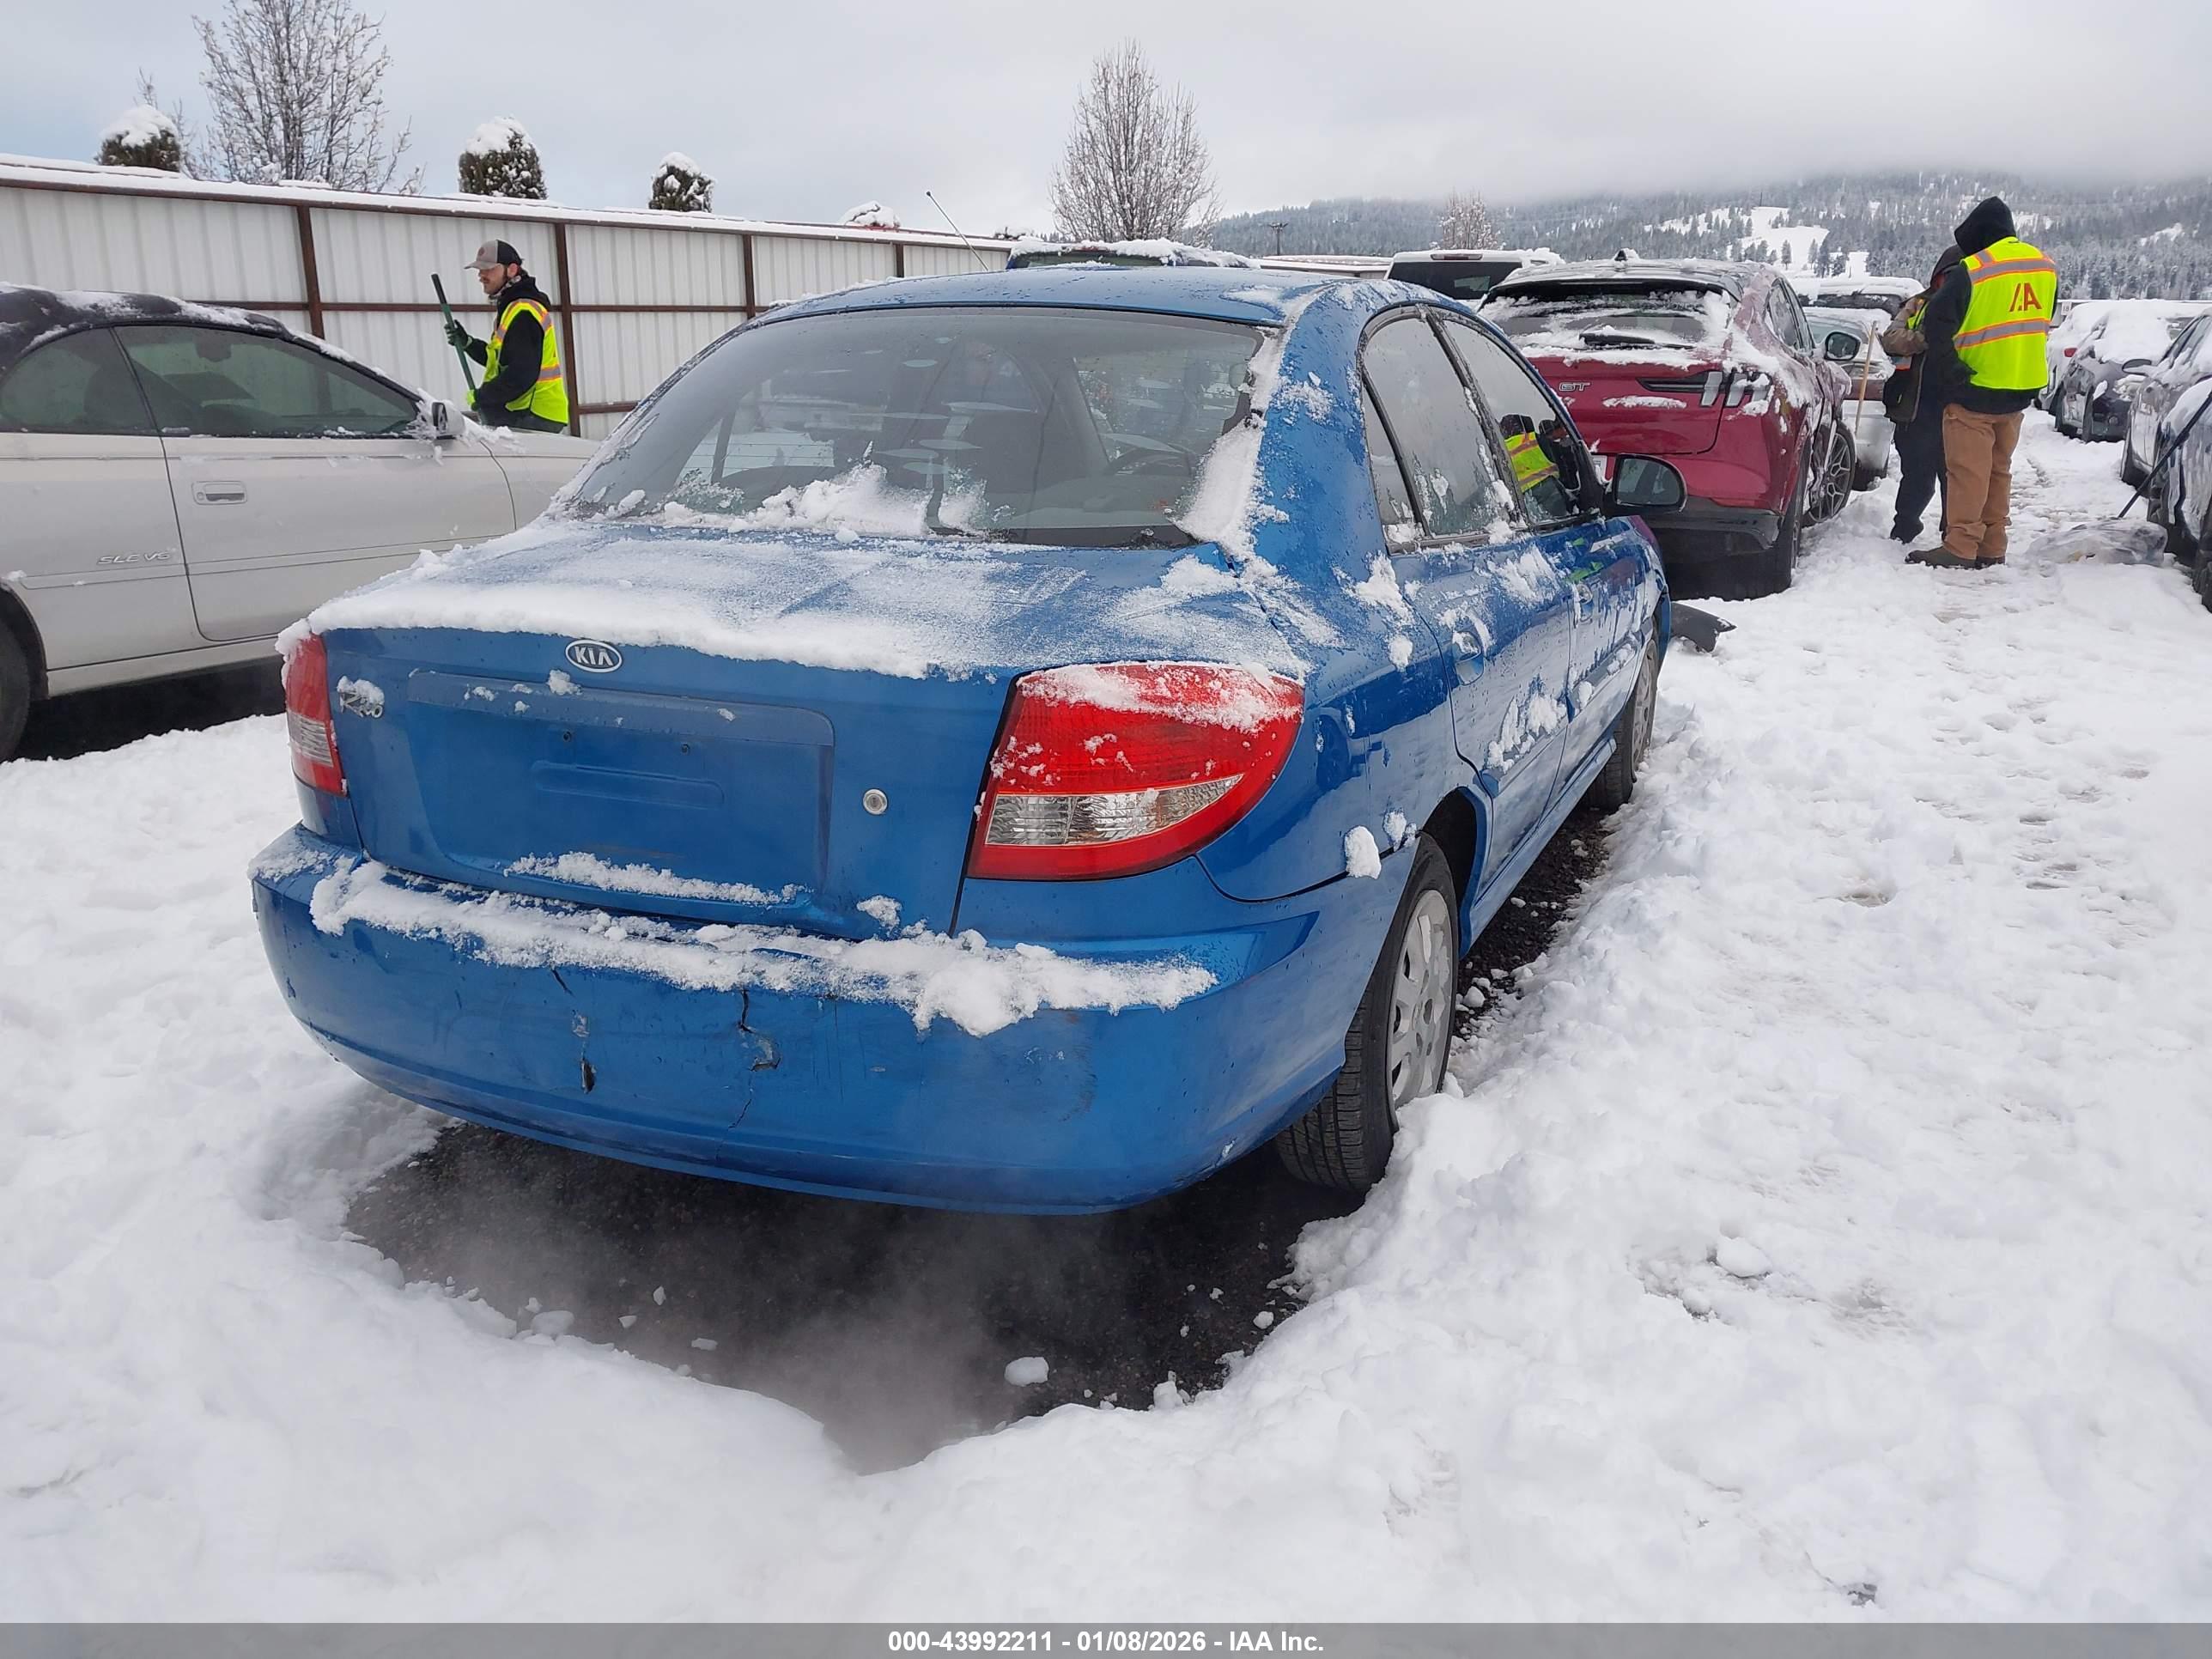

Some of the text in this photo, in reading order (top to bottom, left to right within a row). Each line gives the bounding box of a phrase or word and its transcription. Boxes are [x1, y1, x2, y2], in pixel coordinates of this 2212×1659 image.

[97, 551, 172, 565] SLE V6
[574, 645, 614, 666] KIA
